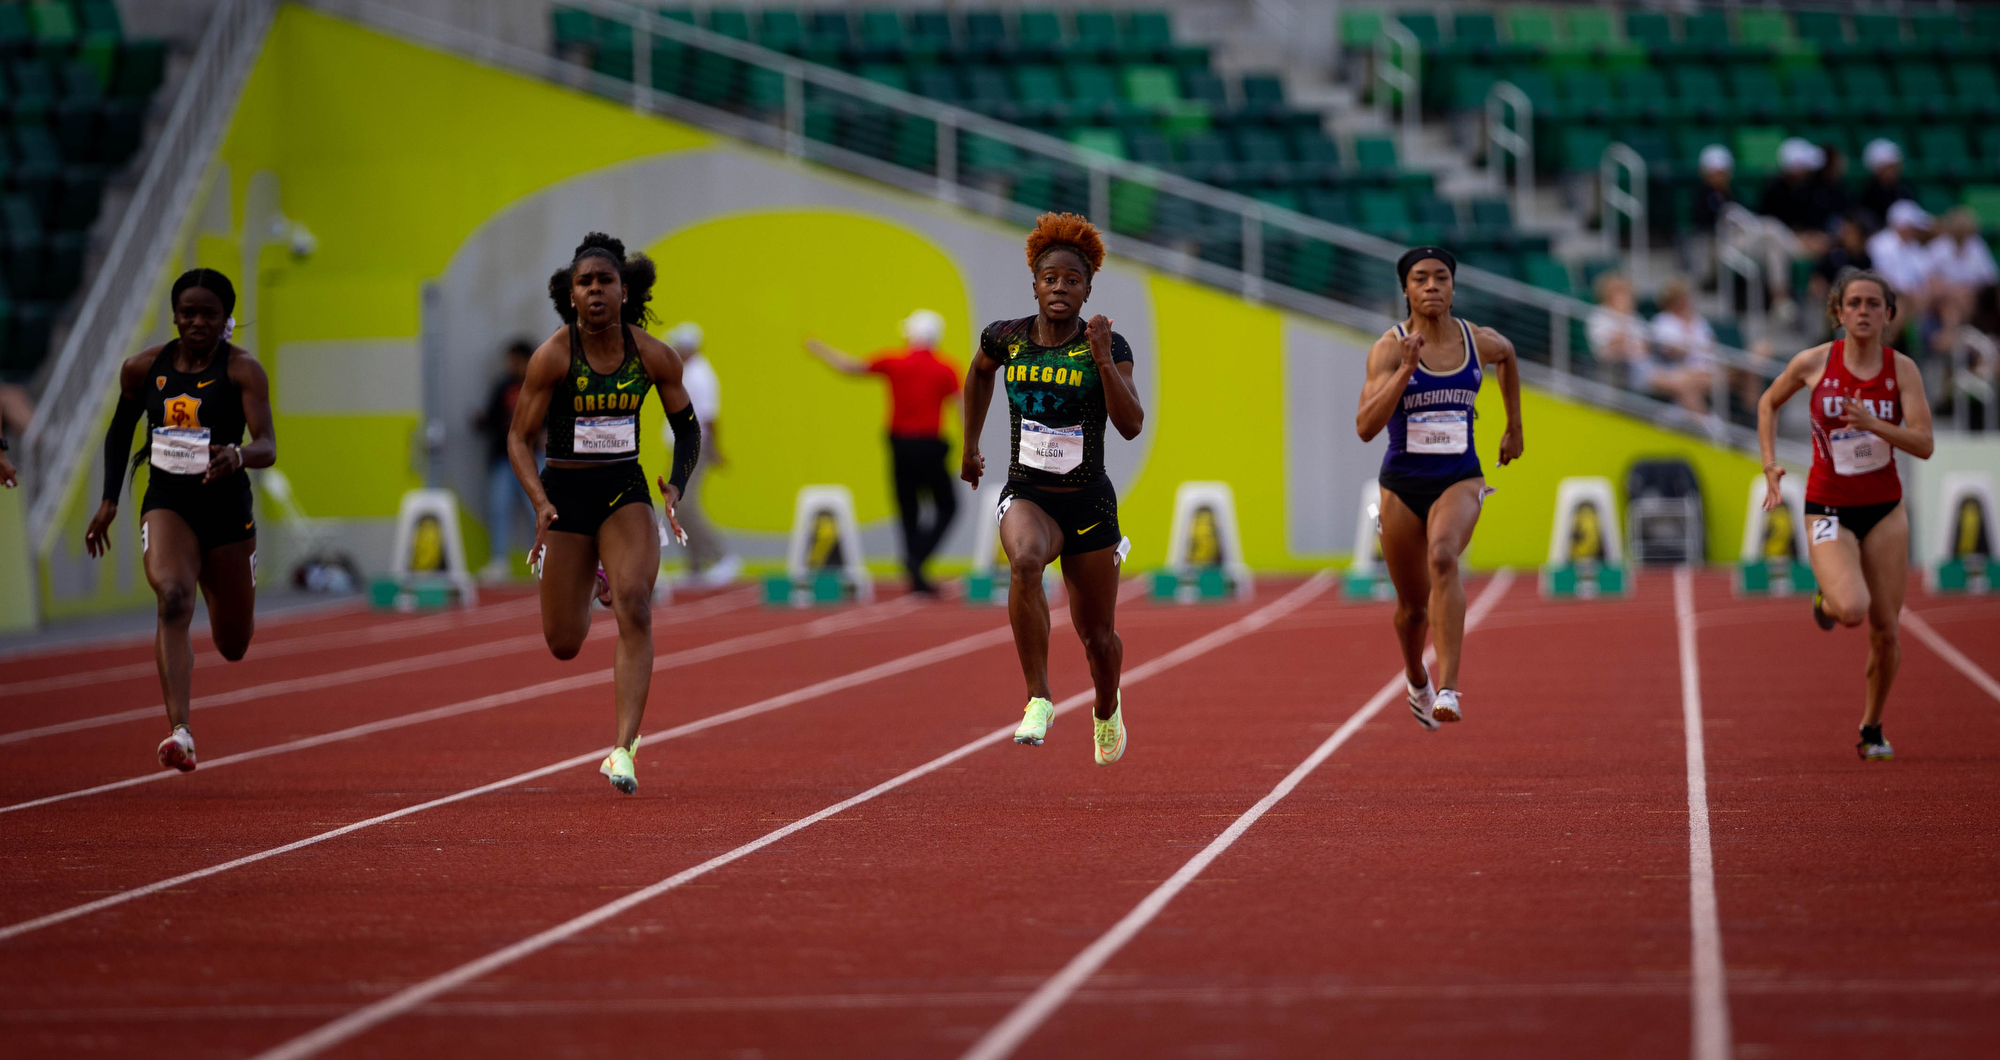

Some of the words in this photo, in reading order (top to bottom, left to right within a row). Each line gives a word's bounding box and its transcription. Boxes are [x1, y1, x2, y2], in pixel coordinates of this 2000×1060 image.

[1006, 365, 1083, 387] OREGON
[574, 393, 640, 412] OREGON
[1822, 396, 1894, 419] UAH
[582, 439, 630, 449] MONTGOMERY
[1036, 447, 1063, 458] NELSON
[1815, 518, 1832, 540] 2
